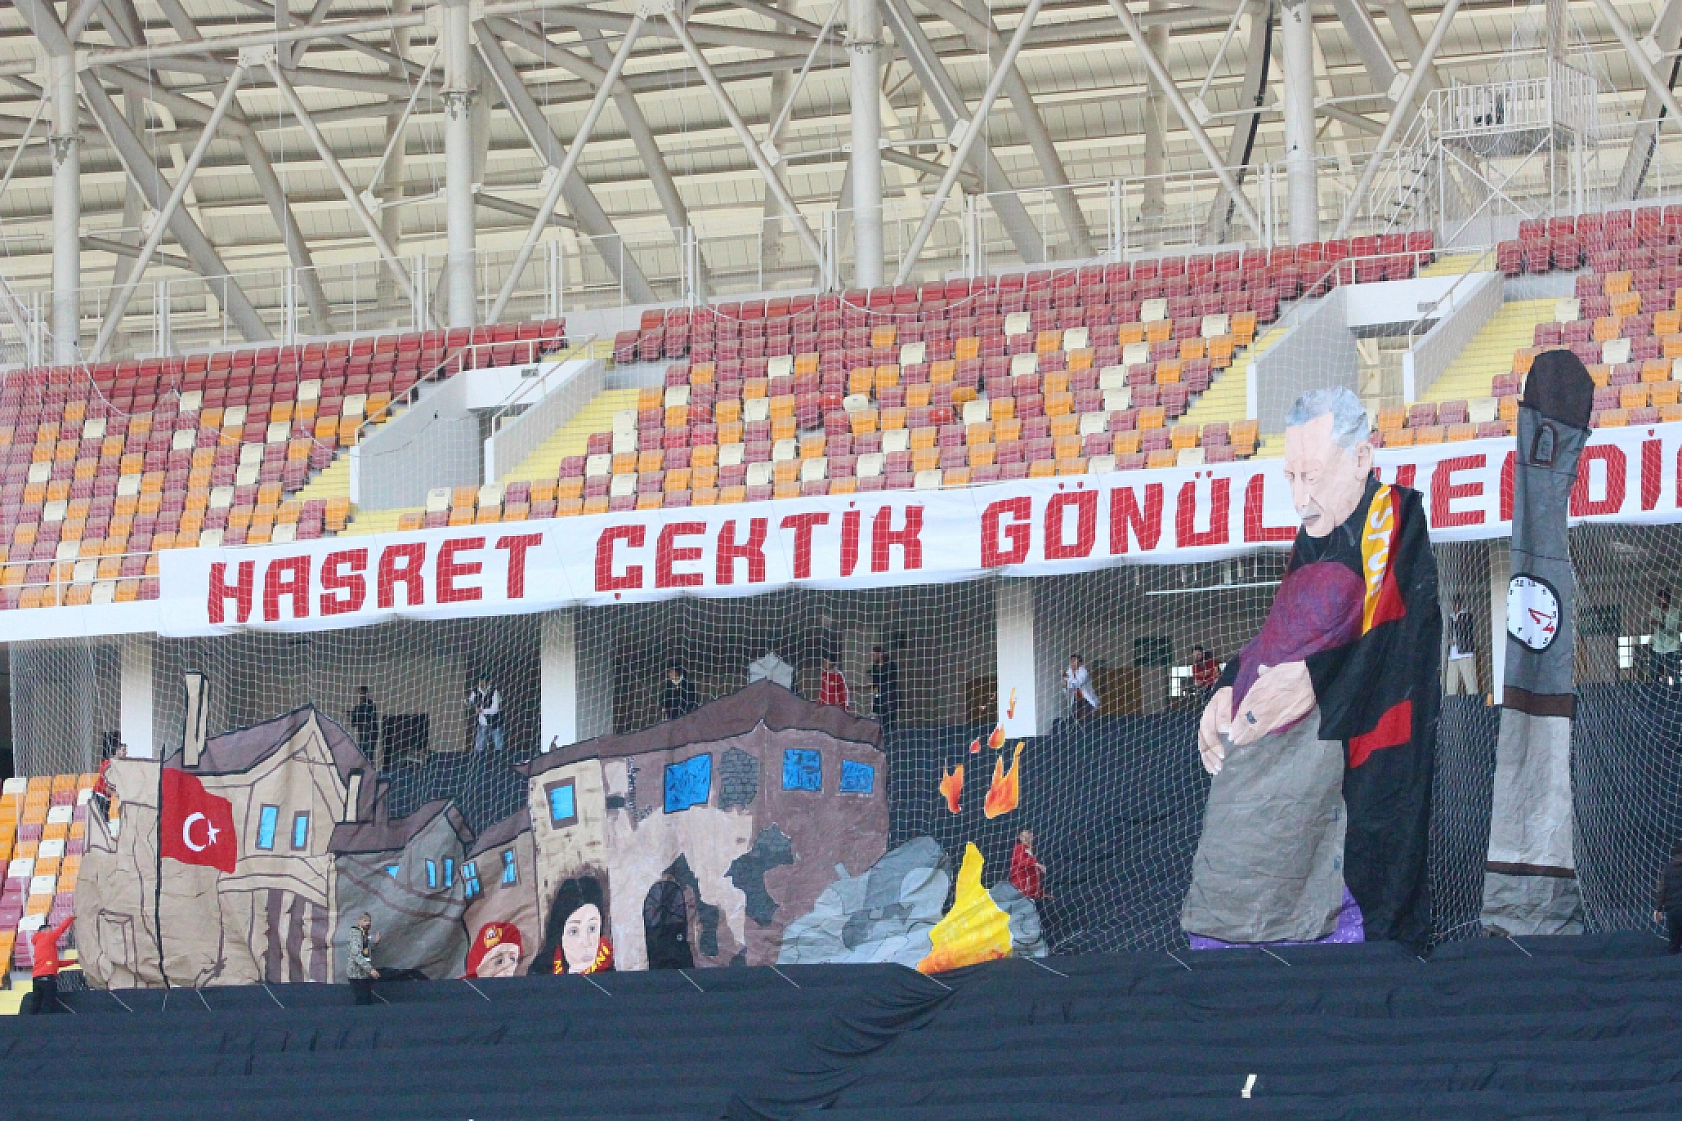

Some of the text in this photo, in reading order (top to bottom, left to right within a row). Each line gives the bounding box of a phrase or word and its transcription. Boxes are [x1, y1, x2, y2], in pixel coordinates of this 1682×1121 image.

[207, 532, 543, 624] HASRET
[594, 501, 925, 600] ÇEKTİK
[980, 470, 1299, 567] GÖNÜL
